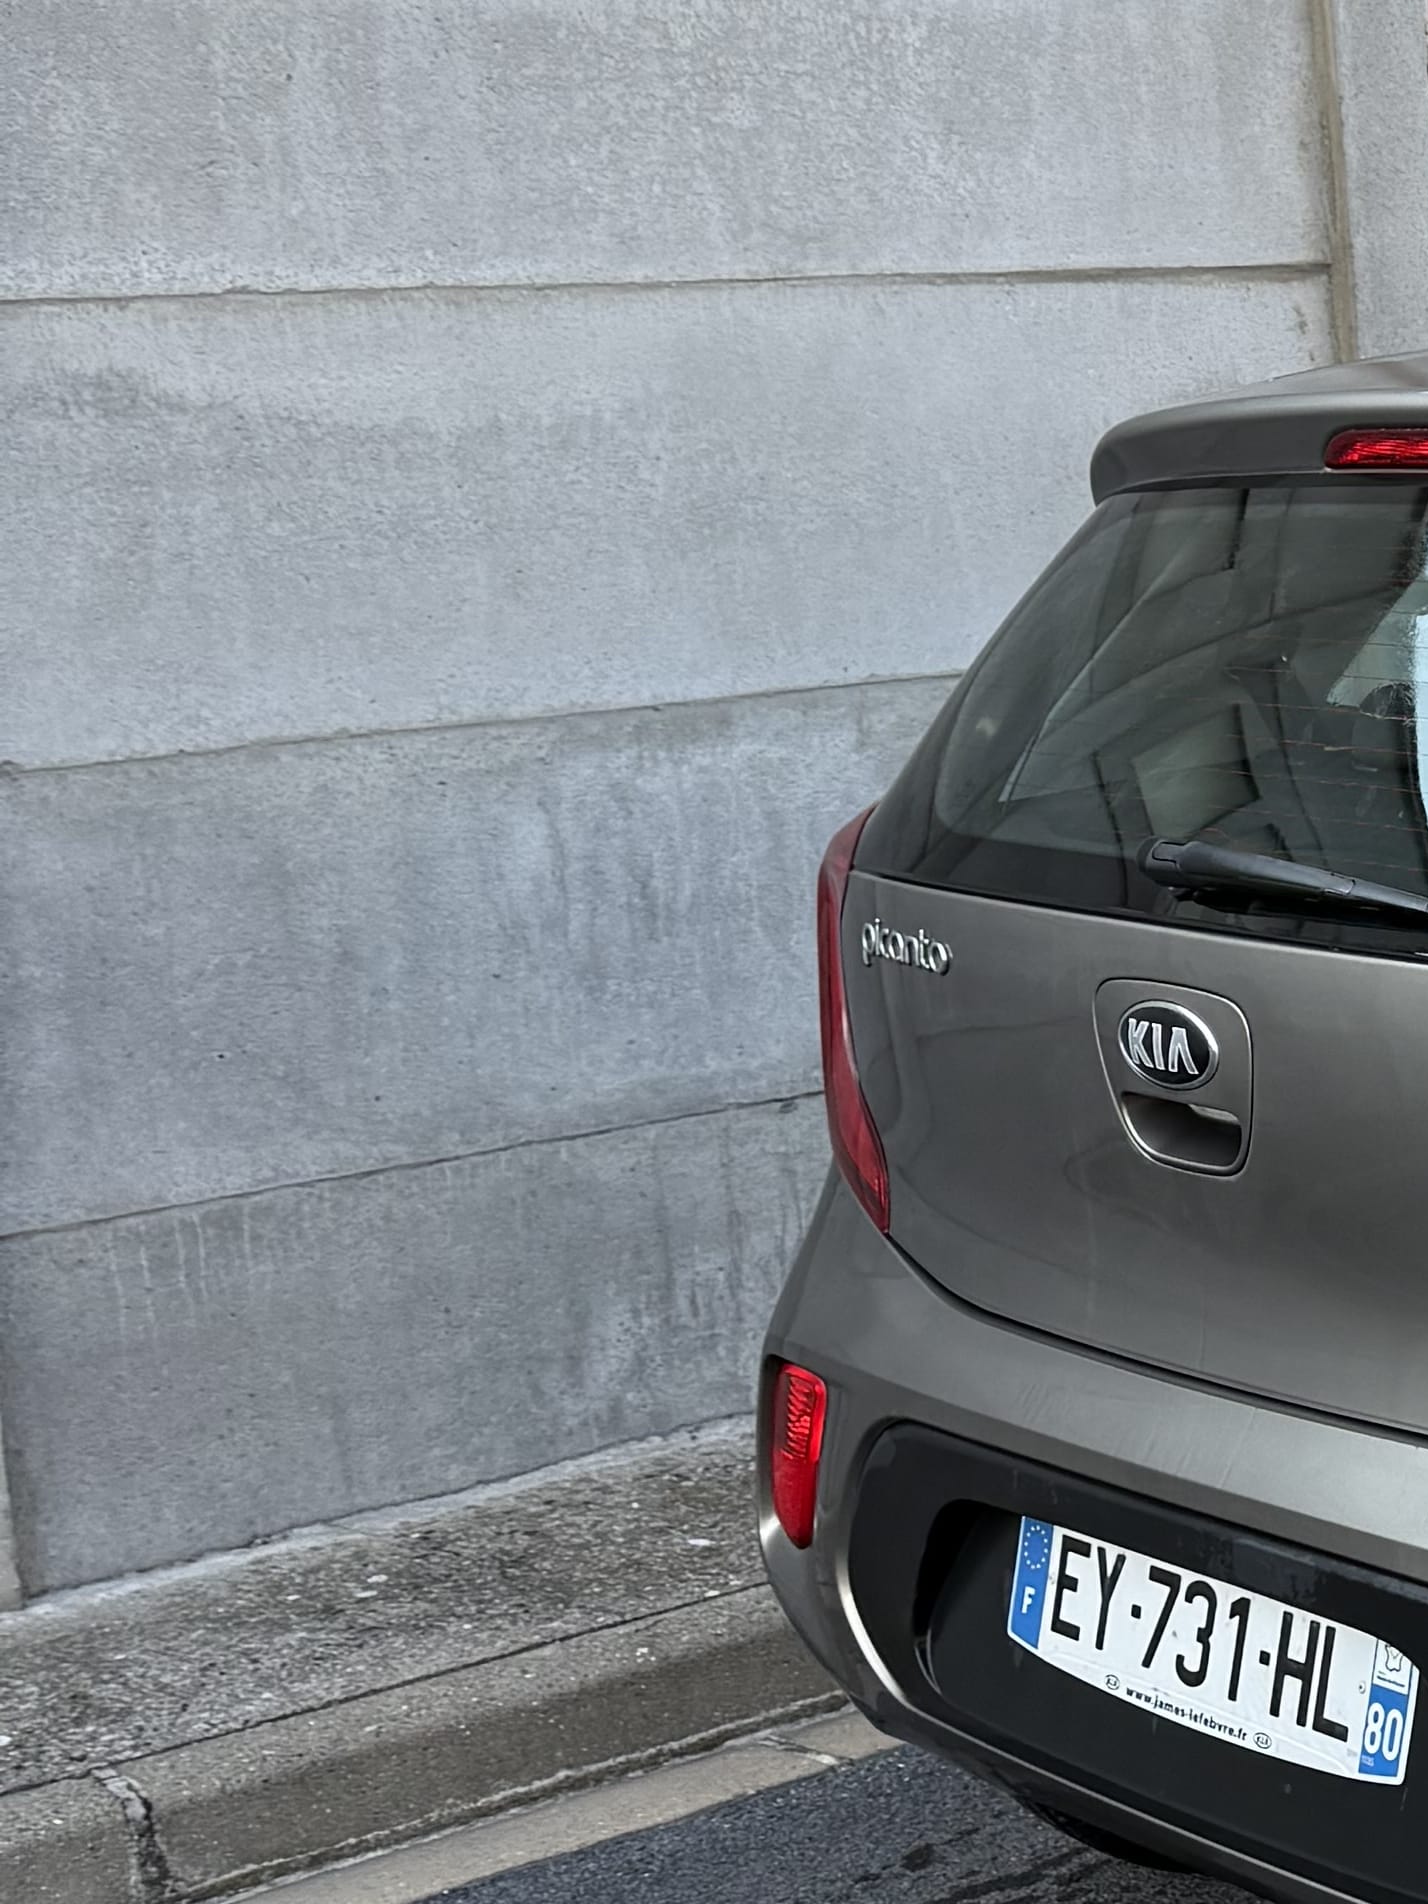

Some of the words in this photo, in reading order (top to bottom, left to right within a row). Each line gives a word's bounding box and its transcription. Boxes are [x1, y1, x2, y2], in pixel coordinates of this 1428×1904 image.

[862, 917, 953, 975] picanto
[1127, 1017, 1200, 1075] KIA
[1021, 1587, 1035, 1614] F
[1126, 1686, 1248, 1742] www.james-lefebvre.fr
[1364, 1702, 1403, 1761] 80
